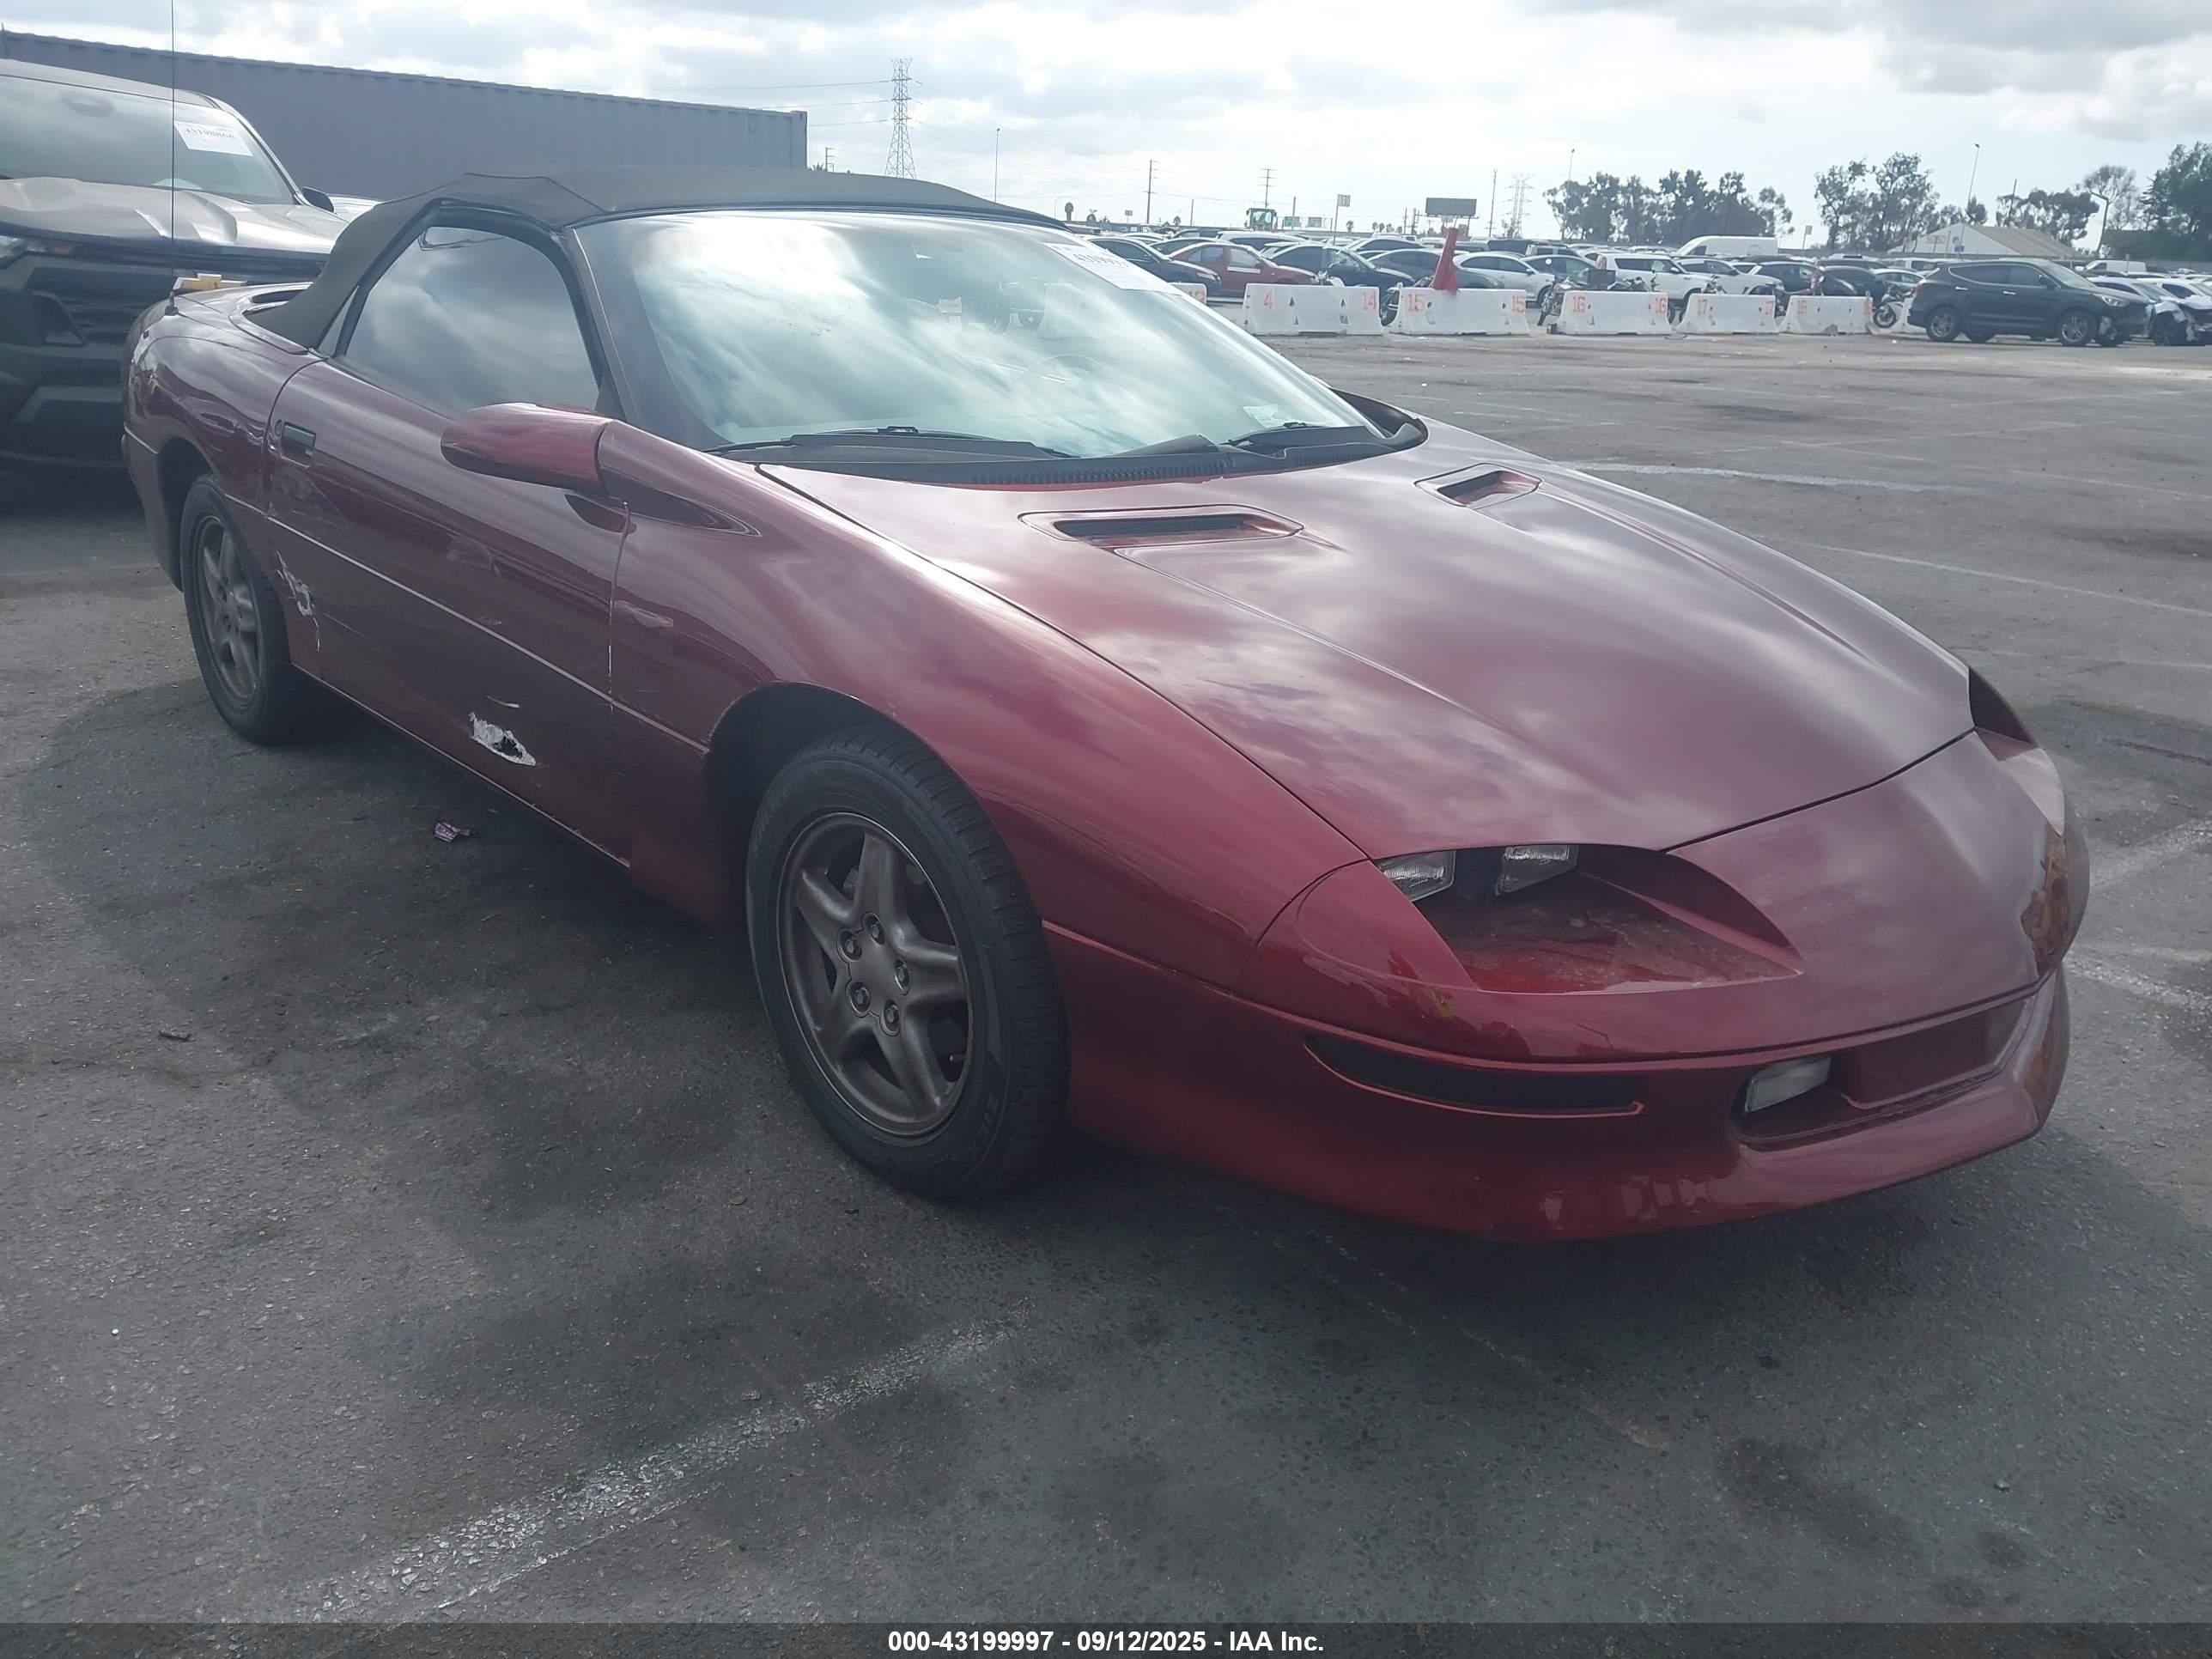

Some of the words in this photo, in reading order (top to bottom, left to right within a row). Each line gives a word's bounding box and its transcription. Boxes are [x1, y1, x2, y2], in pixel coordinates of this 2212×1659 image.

[1363, 291, 1377, 311] 14
[1407, 293, 1425, 313] 15
[1511, 295, 1526, 313] 15
[1572, 295, 1586, 313] 16
[1655, 297, 1668, 314] 16
[1697, 299, 1709, 316] 17
